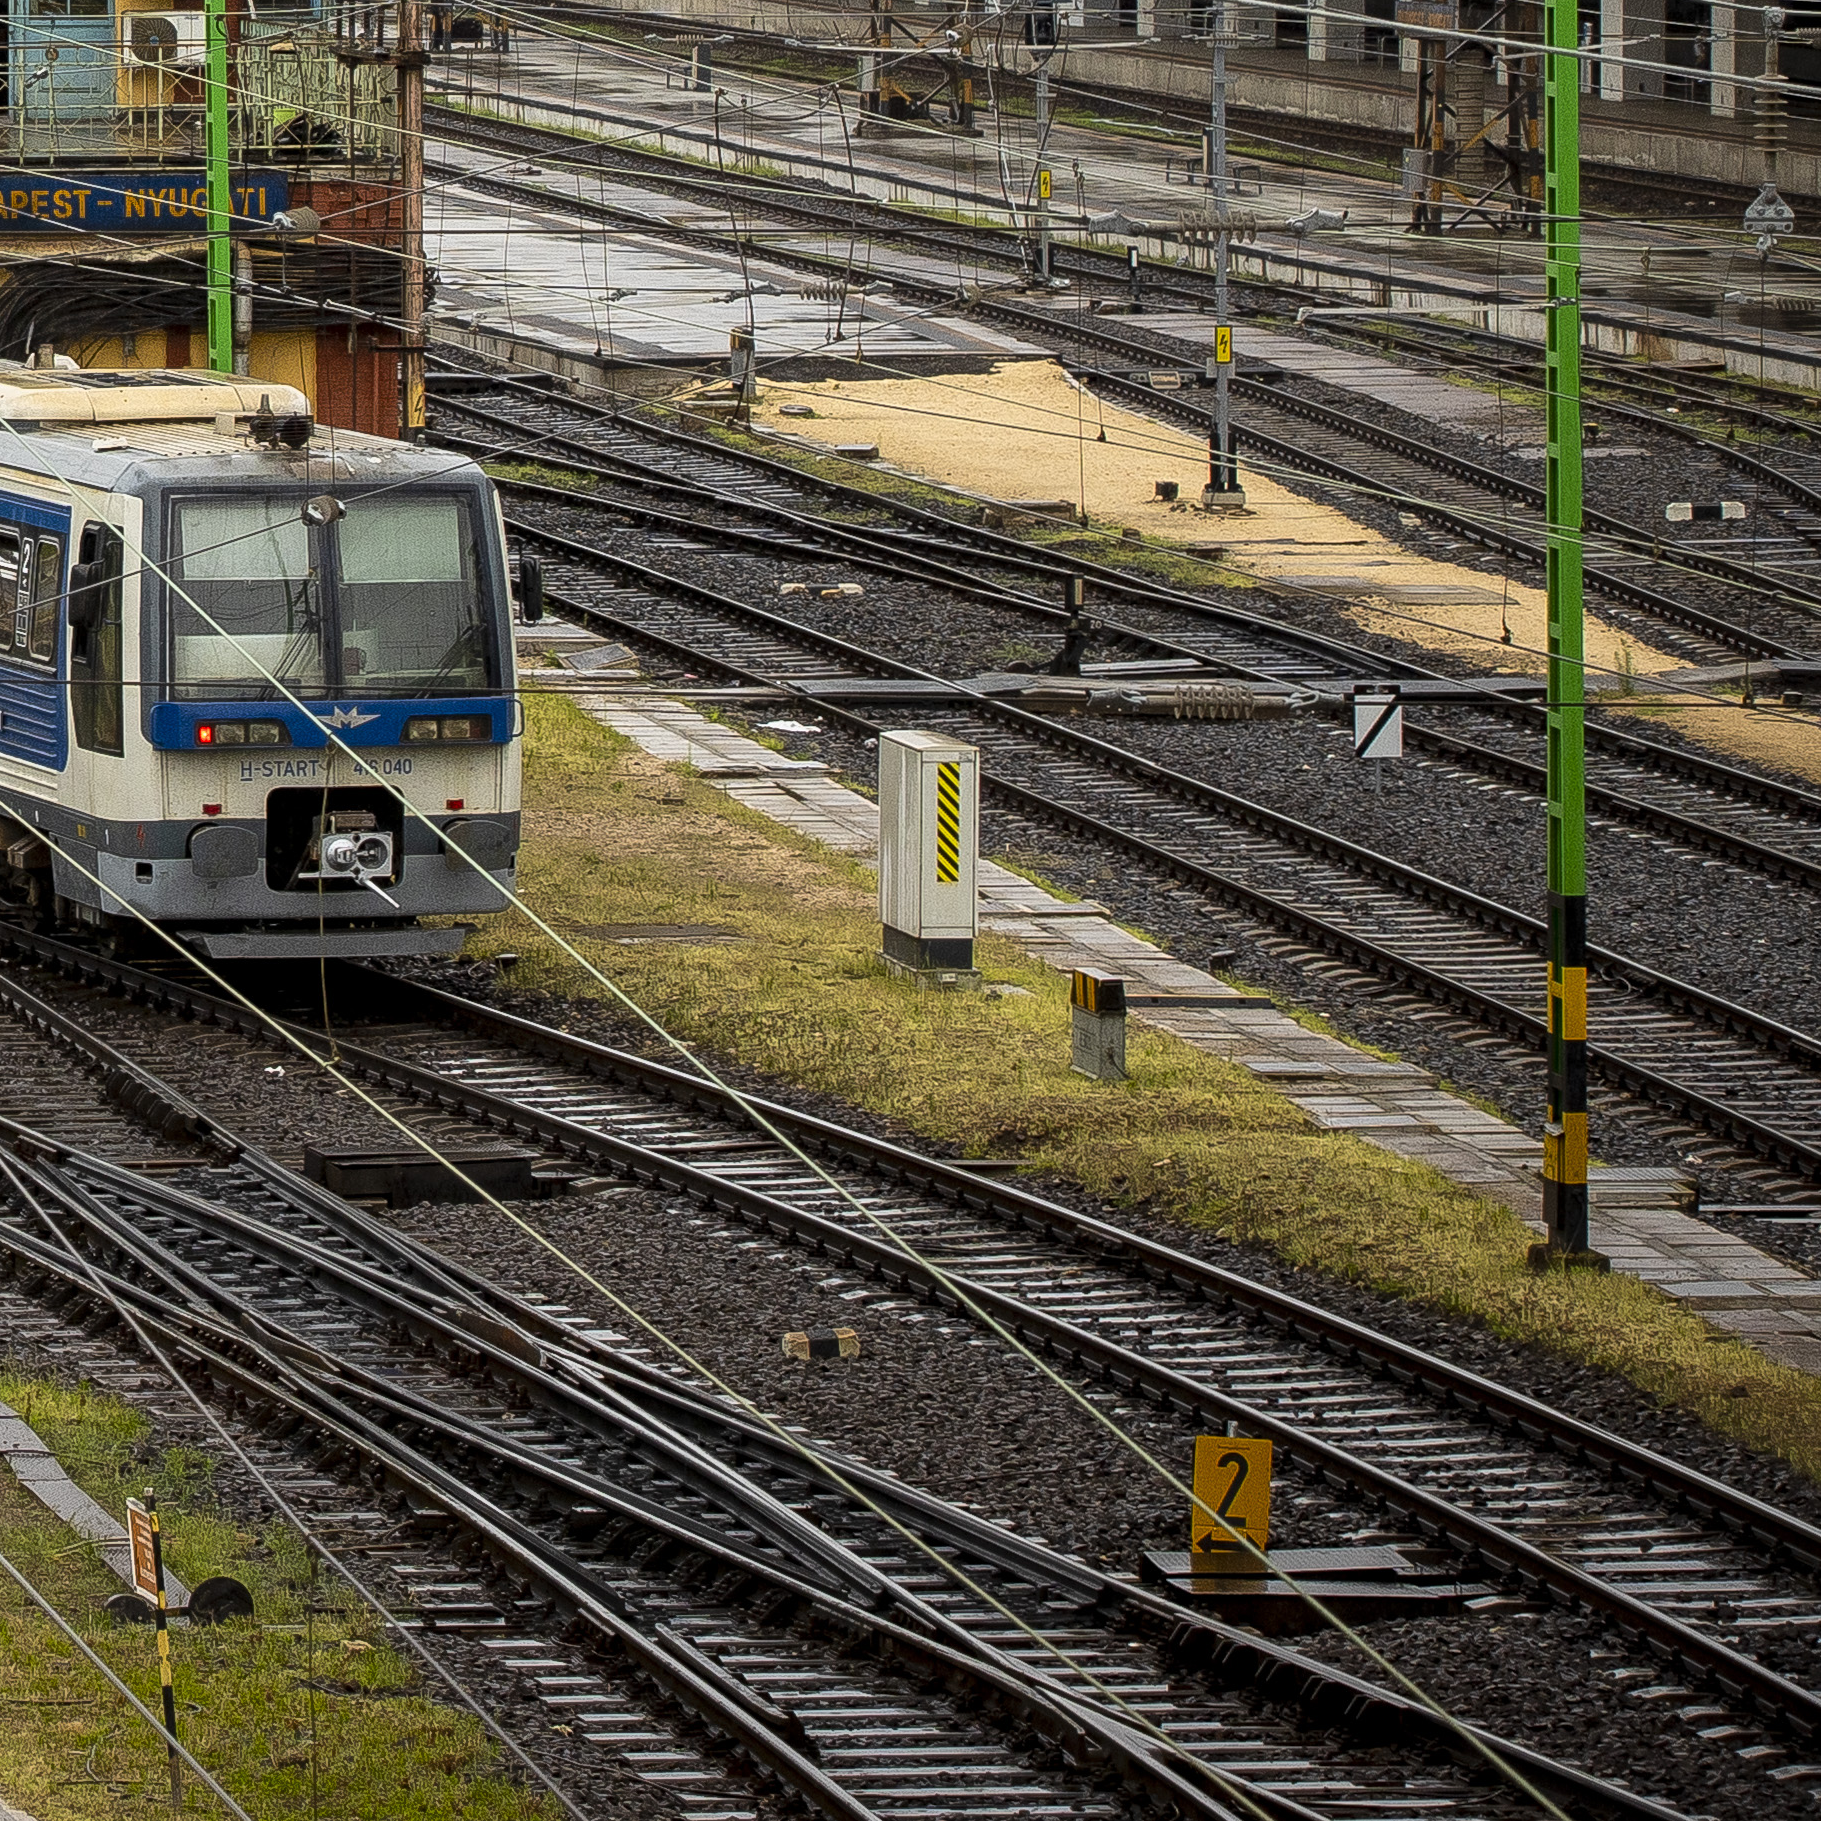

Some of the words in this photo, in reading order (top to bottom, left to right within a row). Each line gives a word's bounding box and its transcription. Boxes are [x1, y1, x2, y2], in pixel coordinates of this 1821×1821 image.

[125, 186, 267, 219] NYUGTI
[23, 542, 32, 574] 2
[240, 759, 320, 782] H-START
[382, 758, 413, 776] 040
[1217, 1451, 1250, 1527] 2
